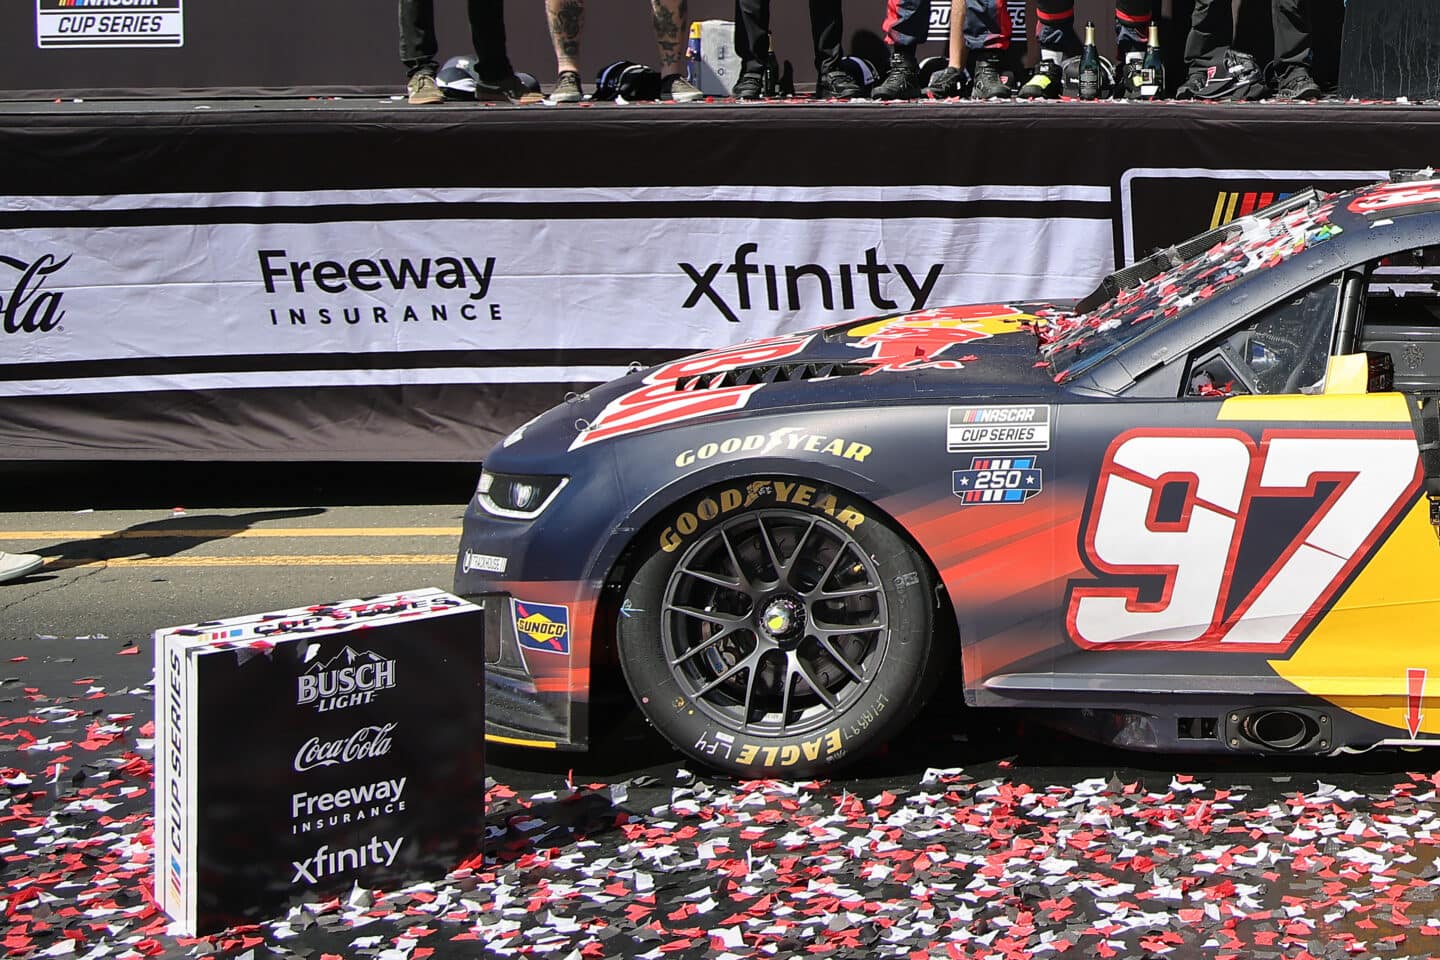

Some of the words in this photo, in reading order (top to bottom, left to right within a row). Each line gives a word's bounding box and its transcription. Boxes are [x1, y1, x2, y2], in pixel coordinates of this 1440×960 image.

[58, 16, 96, 33] CUP
[98, 16, 163, 33] SERIES
[930, 8, 951, 25] CU
[258, 250, 496, 300] Freeway
[678, 243, 944, 323] xfinity
[271, 302, 503, 325] INSURANCE
[961, 429, 988, 441] CUP
[990, 428, 1035, 441] SERIES
[980, 408, 1035, 423] NASCAR
[675, 427, 873, 468] GOODYEAR
[974, 470, 1022, 489] 250
[659, 480, 865, 552] GOODYEAR
[1067, 428, 1425, 652] 97
[519, 621, 564, 636] SUNOCO
[297, 659, 396, 704] BUSCH
[318, 692, 373, 712] LIGHT
[170, 649, 183, 778] SERIES
[294, 721, 399, 772] Coca-Cola
[736, 728, 844, 767] EAGLE
[170, 780, 183, 856] CUP
[292, 777, 407, 818] Freeway
[292, 801, 407, 835] INSURANCE
[291, 835, 404, 884] xfinity
